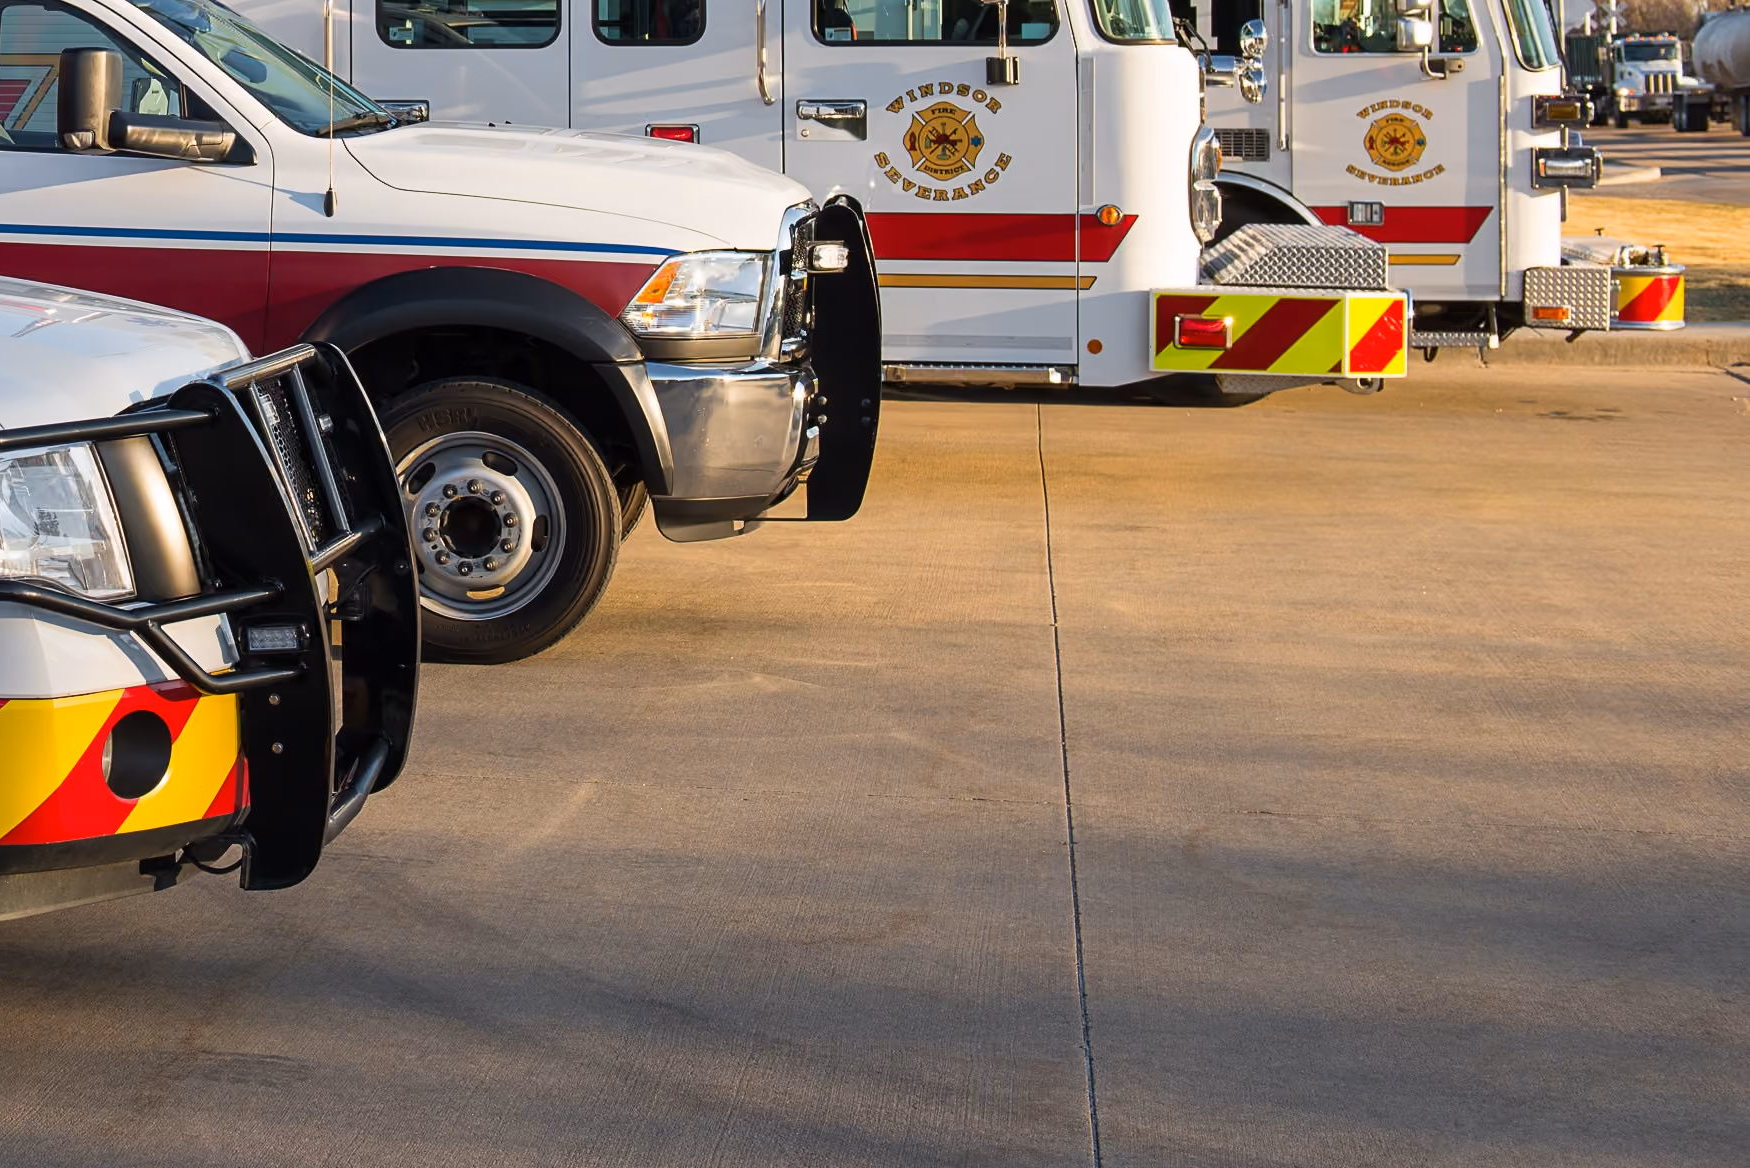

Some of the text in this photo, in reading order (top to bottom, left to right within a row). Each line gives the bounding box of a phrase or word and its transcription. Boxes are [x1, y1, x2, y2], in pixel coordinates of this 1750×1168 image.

[886, 82, 1002, 114] WINDSOR
[931, 107, 957, 116] FIRE
[1356, 99, 1434, 120] WINDSOR
[874, 152, 1012, 201] SEVERANCE
[924, 164, 965, 175] DISTRICT
[1346, 163, 1445, 186] SEVERANCE
